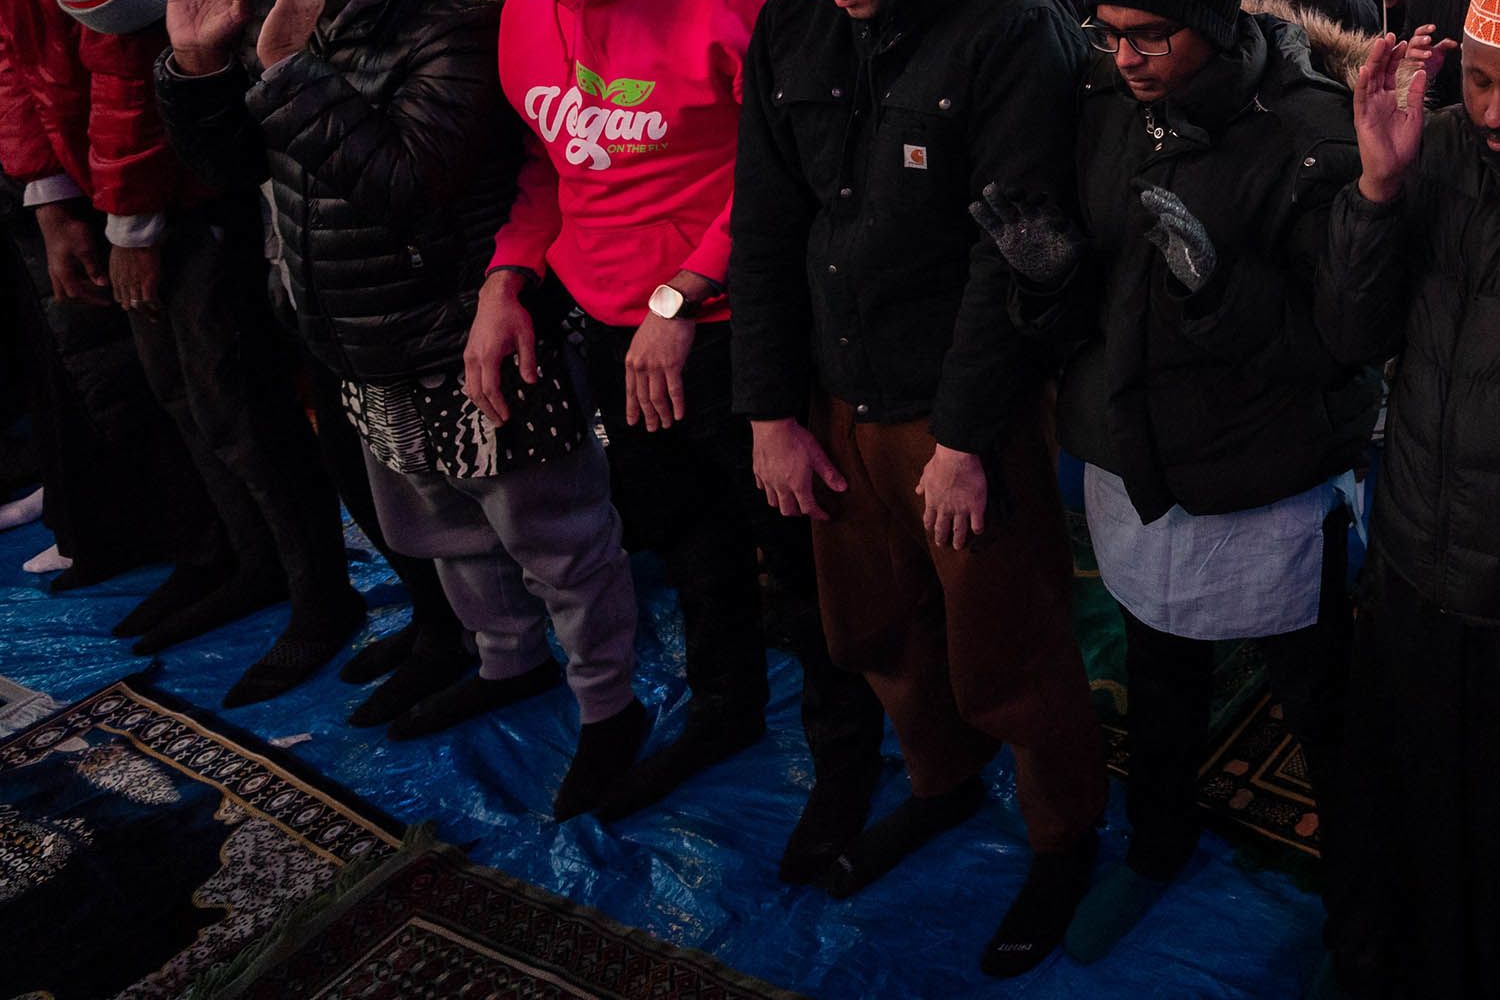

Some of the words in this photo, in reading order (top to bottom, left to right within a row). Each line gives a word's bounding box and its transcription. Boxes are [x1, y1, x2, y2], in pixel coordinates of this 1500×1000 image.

[525, 85, 668, 170] Vegan
[608, 145, 624, 153] ON
[626, 144, 646, 153] THE
[648, 142, 669, 151] FLY
